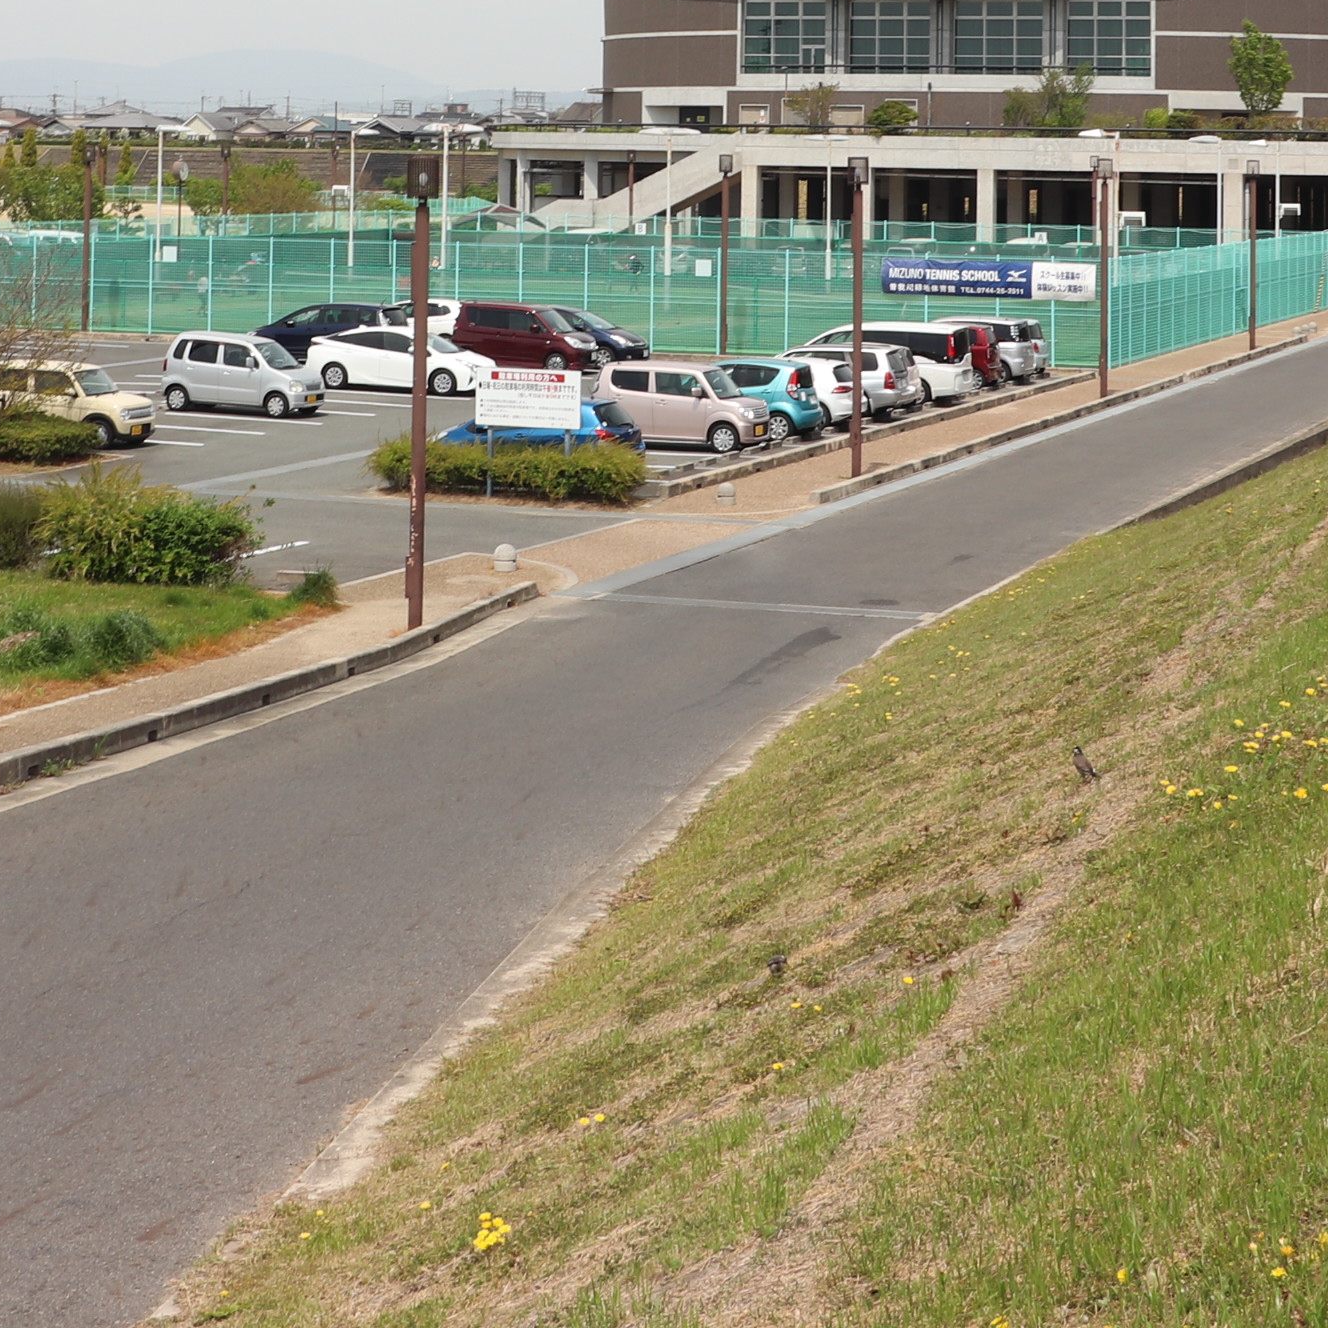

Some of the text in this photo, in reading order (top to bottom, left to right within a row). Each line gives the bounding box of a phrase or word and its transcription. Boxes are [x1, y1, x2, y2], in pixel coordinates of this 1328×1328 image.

[888, 267, 1001, 282] MIZUNO TENNIS SCHOOL
